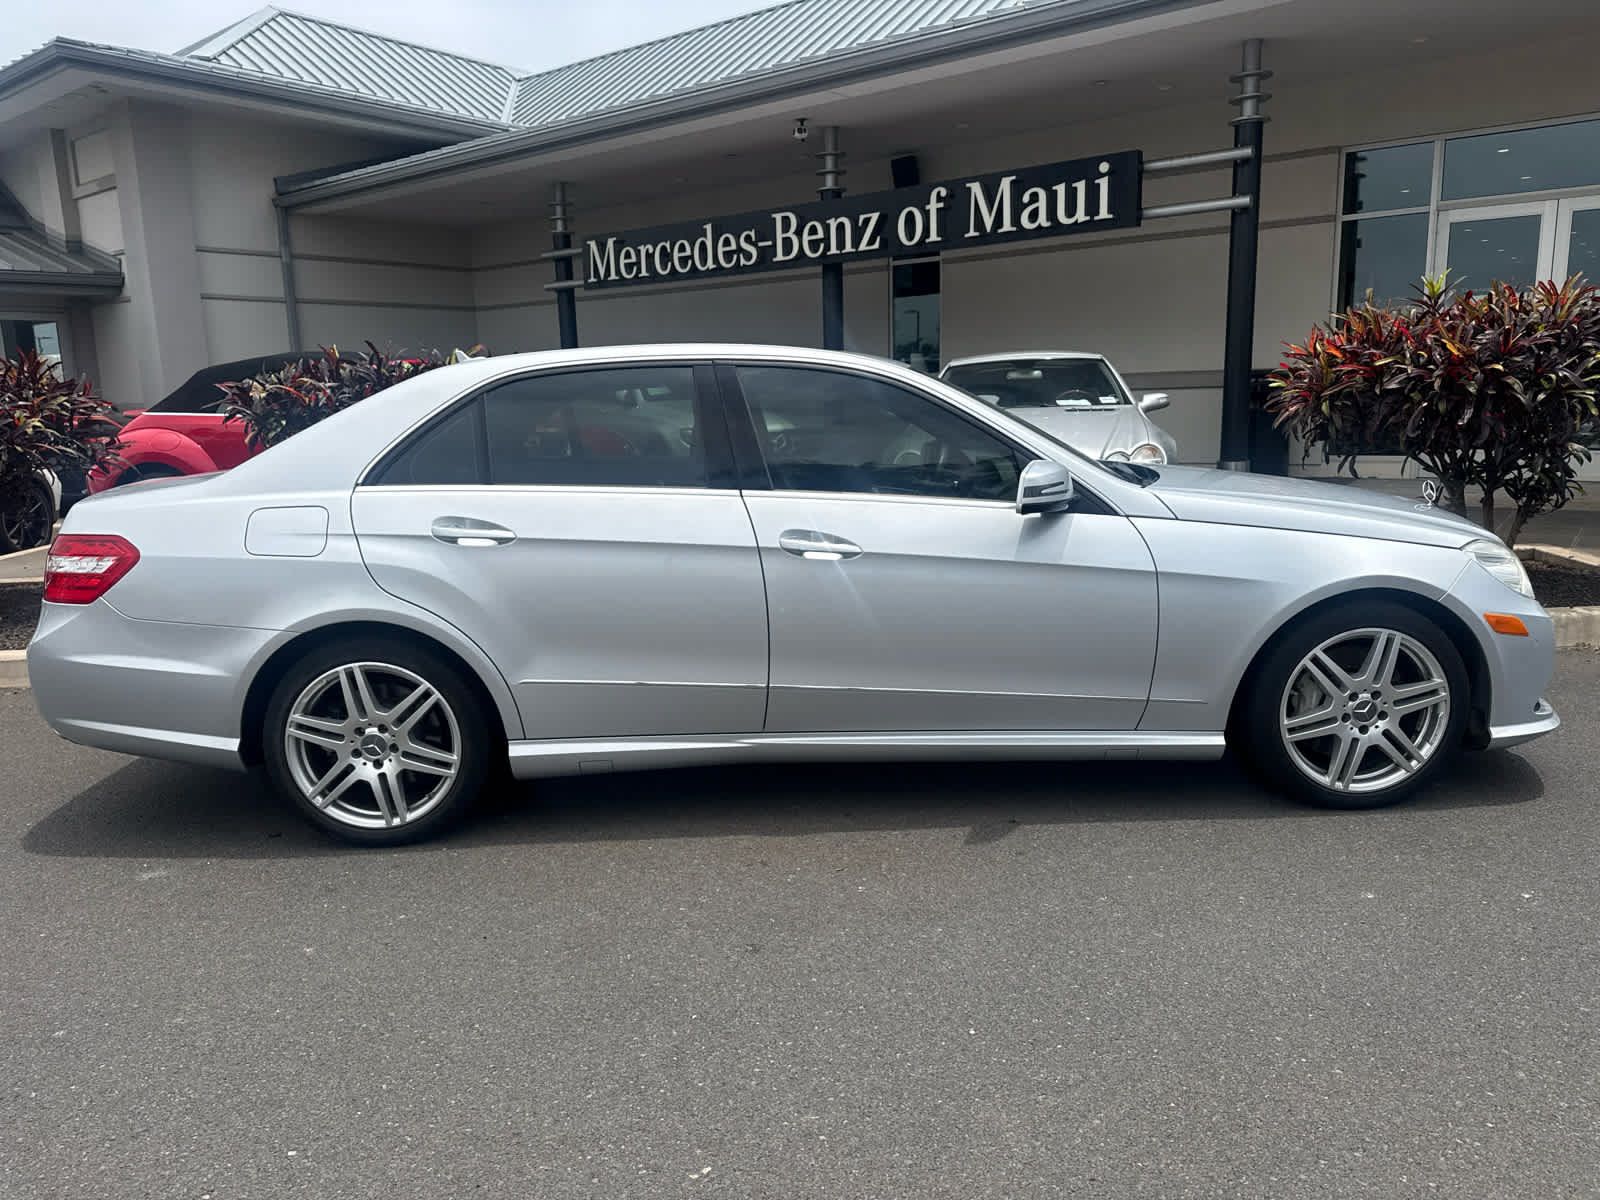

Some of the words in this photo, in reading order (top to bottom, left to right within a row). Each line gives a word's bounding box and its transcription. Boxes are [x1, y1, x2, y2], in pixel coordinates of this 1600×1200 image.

[586, 211, 881, 283] Mercedes-Benz
[897, 187, 947, 246] of
[964, 161, 1113, 238] Maui
